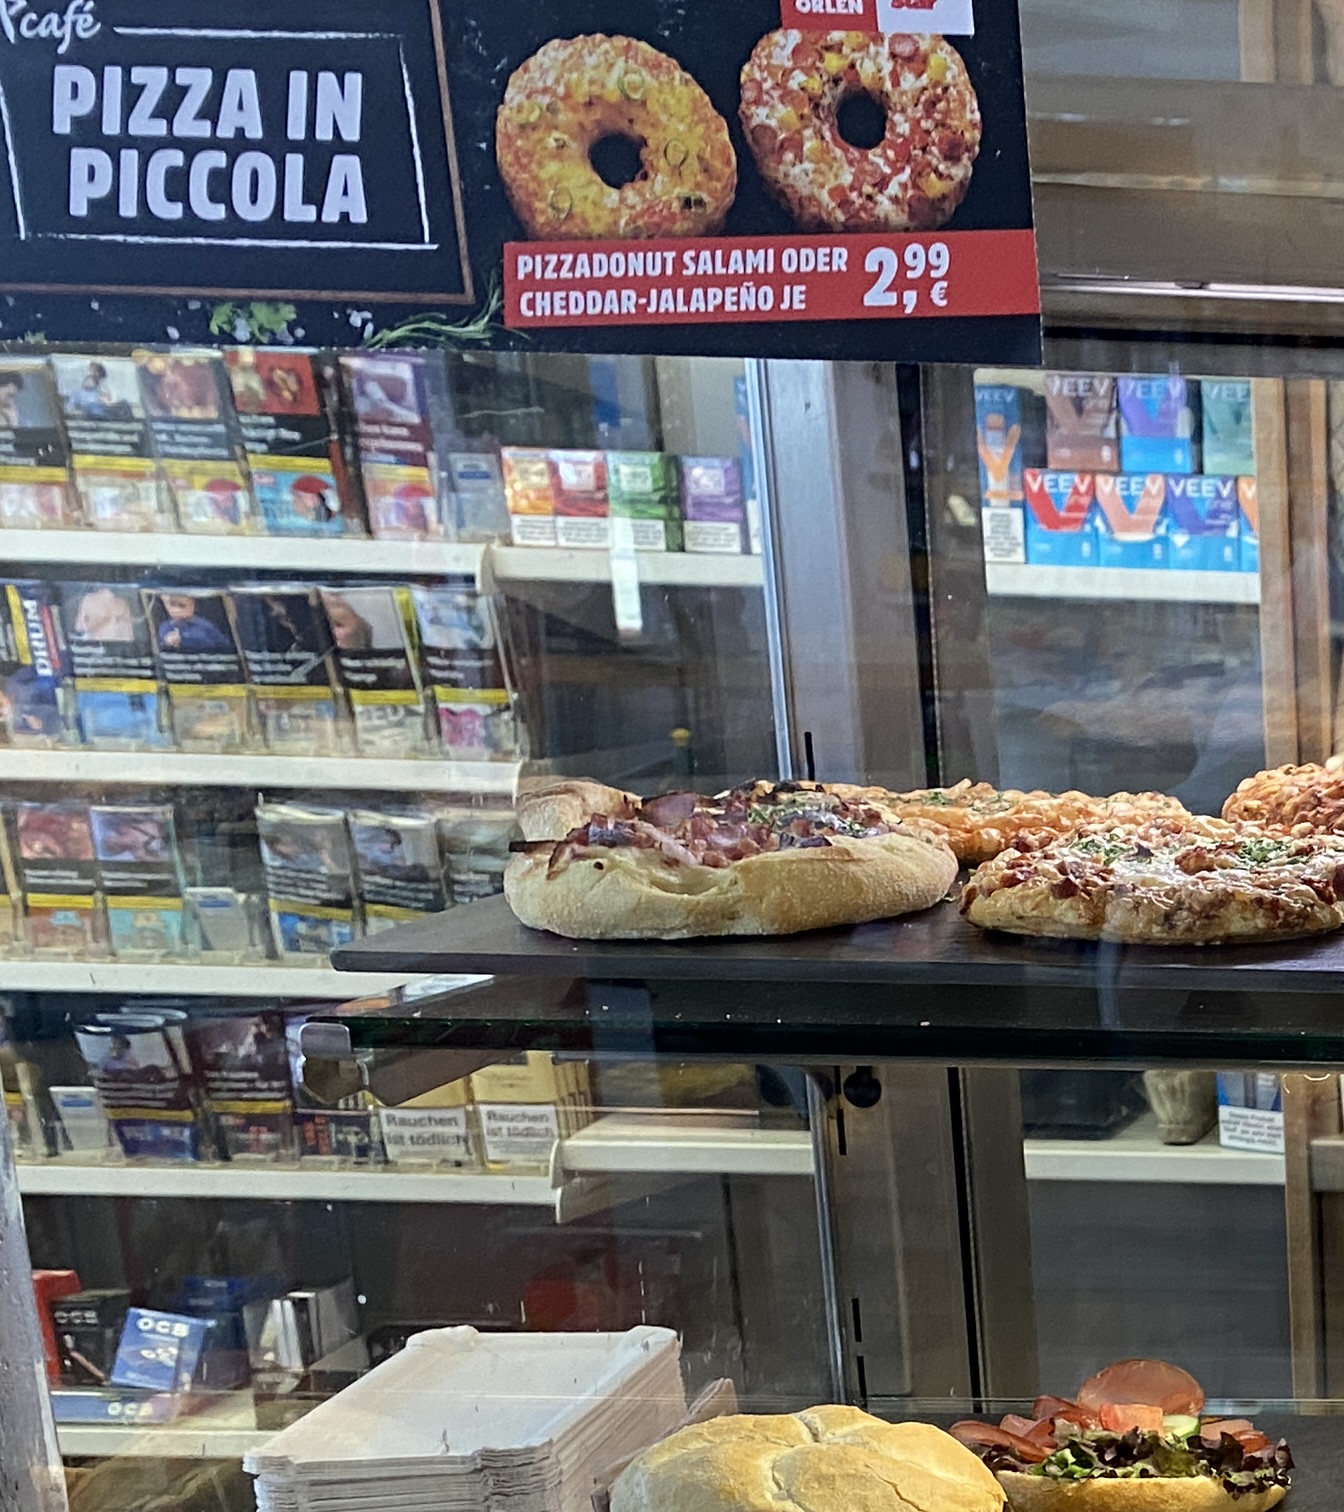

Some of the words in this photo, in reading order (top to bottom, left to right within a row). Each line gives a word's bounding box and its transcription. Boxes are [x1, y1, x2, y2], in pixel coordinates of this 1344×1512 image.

[19, 0, 101, 54] café
[52, 64, 264, 140] PIZZA
[286, 69, 364, 142] IN
[69, 147, 368, 224] PICCOLA
[517, 250, 677, 281] PIZZADONUT
[682, 248, 775, 277] SALAMI
[781, 246, 849, 274] ODER
[519, 281, 774, 318] CHEDDAR-JALAPEÑO
[779, 284, 807, 311] JE
[1025, 472, 1092, 494] VEEV
[1097, 475, 1164, 496] VEEV
[1168, 477, 1236, 498] VEEV
[23, 600, 53, 676] DRUM
[386, 1113, 459, 1128] Rauchen
[486, 1110, 549, 1124] Rauchen
[54, 1309, 99, 1326] OCB
[136, 1317, 190, 1338] OCB
